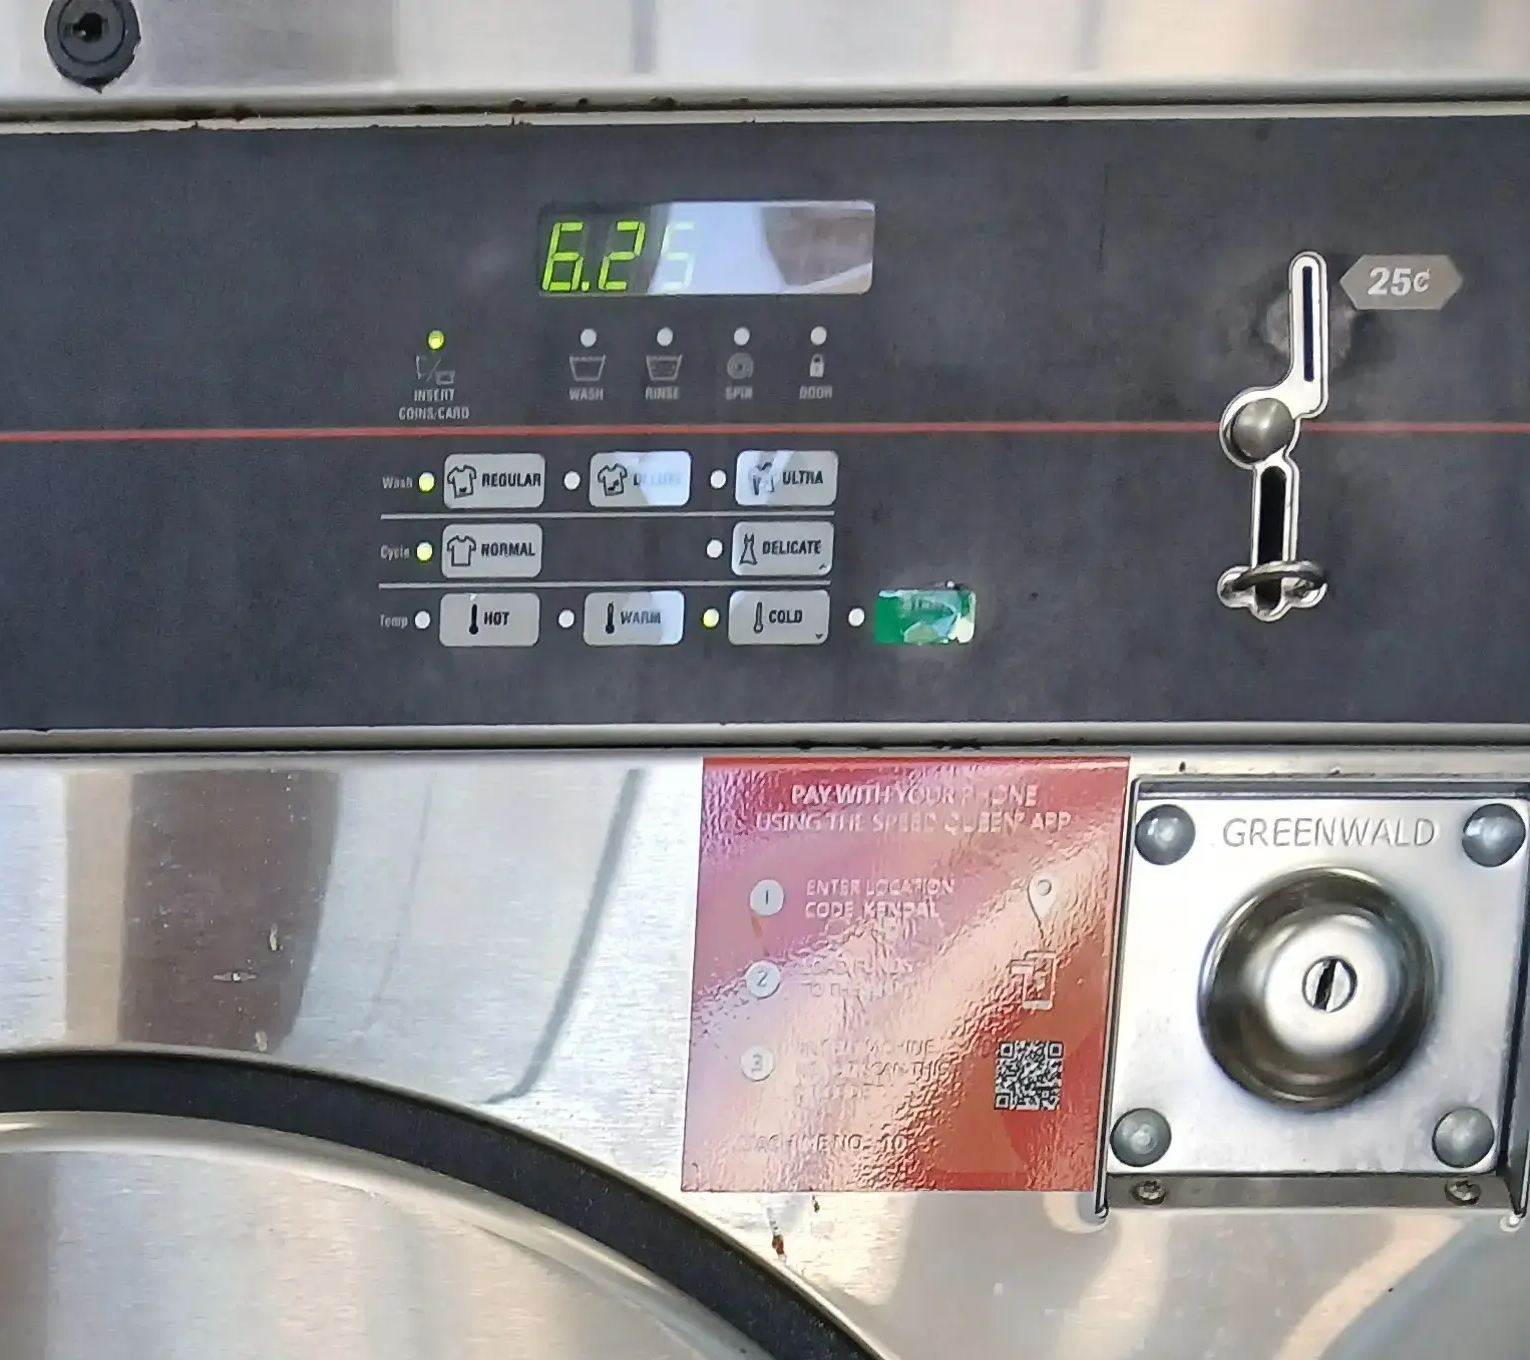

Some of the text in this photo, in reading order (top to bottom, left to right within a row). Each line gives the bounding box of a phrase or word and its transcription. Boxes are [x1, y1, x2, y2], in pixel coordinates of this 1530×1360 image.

[540, 220, 696, 292] 6.25
[1366, 265, 1431, 297] 25¢
[413, 387, 455, 403] INSERT
[569, 387, 604, 401] WASH
[645, 386, 680, 401] RINSE
[724, 386, 753, 400] SPIN
[799, 385, 834, 400] DOOR
[381, 475, 413, 490] Wash
[480, 471, 542, 489] REGULAR
[782, 469, 824, 487] ULTRA
[379, 544, 411, 561] Cycle
[480, 541, 536, 558] NORMAL
[761, 539, 822, 556] DELICATE
[378, 613, 409, 630] Temp
[483, 610, 510, 627] HOT
[619, 609, 662, 626] WARM
[768, 608, 803, 624] COLD
[790, 784, 833, 805] PAY
[834, 784, 890, 804] WITH
[895, 784, 956, 804] YOUR
[754, 812, 821, 833] USING
[827, 812, 866, 833] THE
[1029, 811, 1072, 831] APP
[1222, 817, 1438, 848] GREENWALD
[805, 878, 956, 896] ENTER LOCATION
